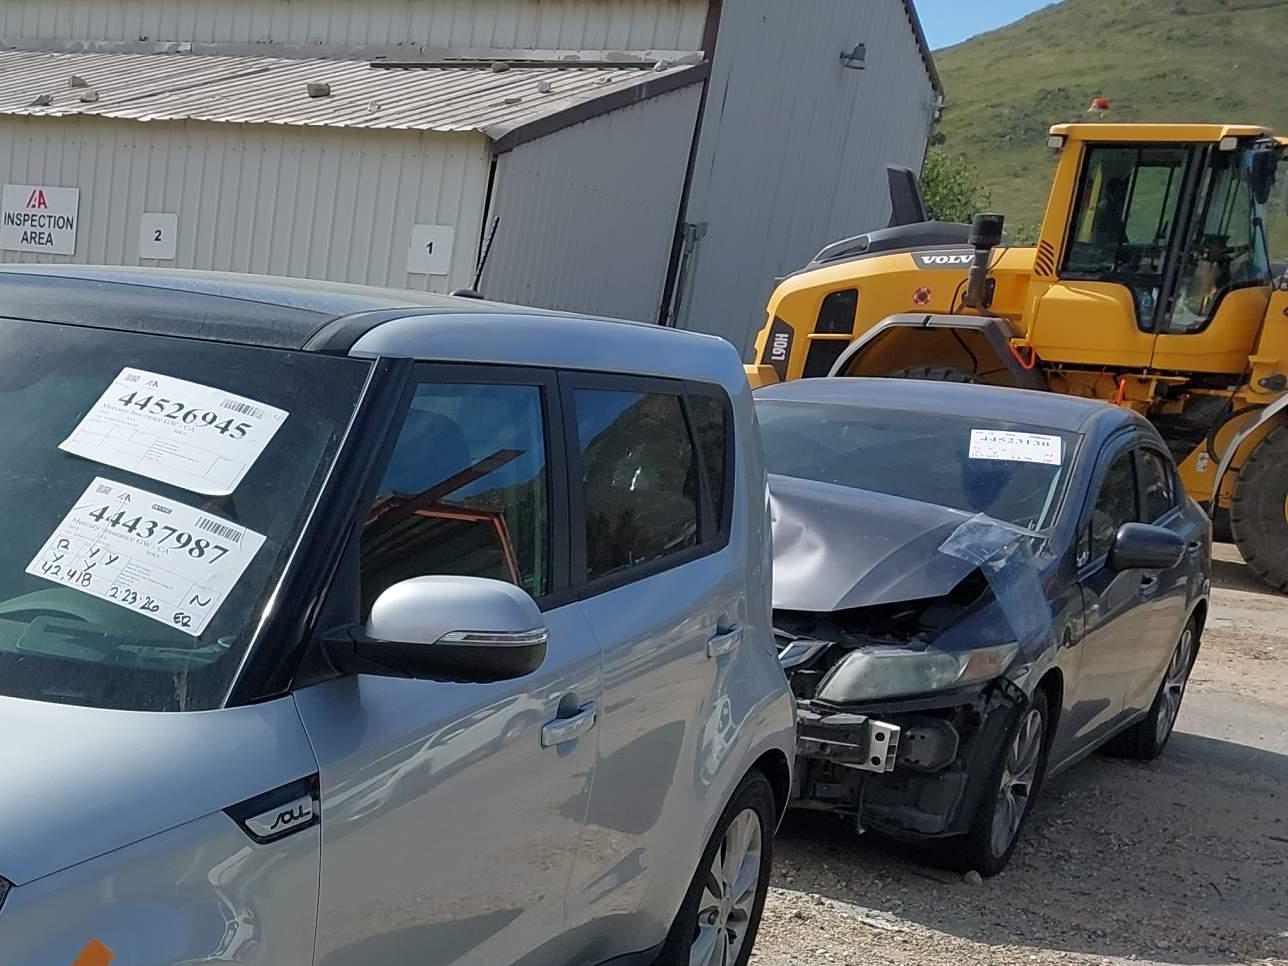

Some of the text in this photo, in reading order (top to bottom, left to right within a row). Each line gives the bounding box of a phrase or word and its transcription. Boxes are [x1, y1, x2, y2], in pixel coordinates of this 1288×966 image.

[3, 212, 74, 230] INSPECTION
[20, 230, 54, 246] AREA
[154, 229, 162, 242] 2
[426, 241, 433, 255] 1
[920, 255, 975, 264] VOLV
[771, 333, 789, 361] L90H
[118, 391, 254, 441] 44526945
[89, 505, 230, 564] 44437987
